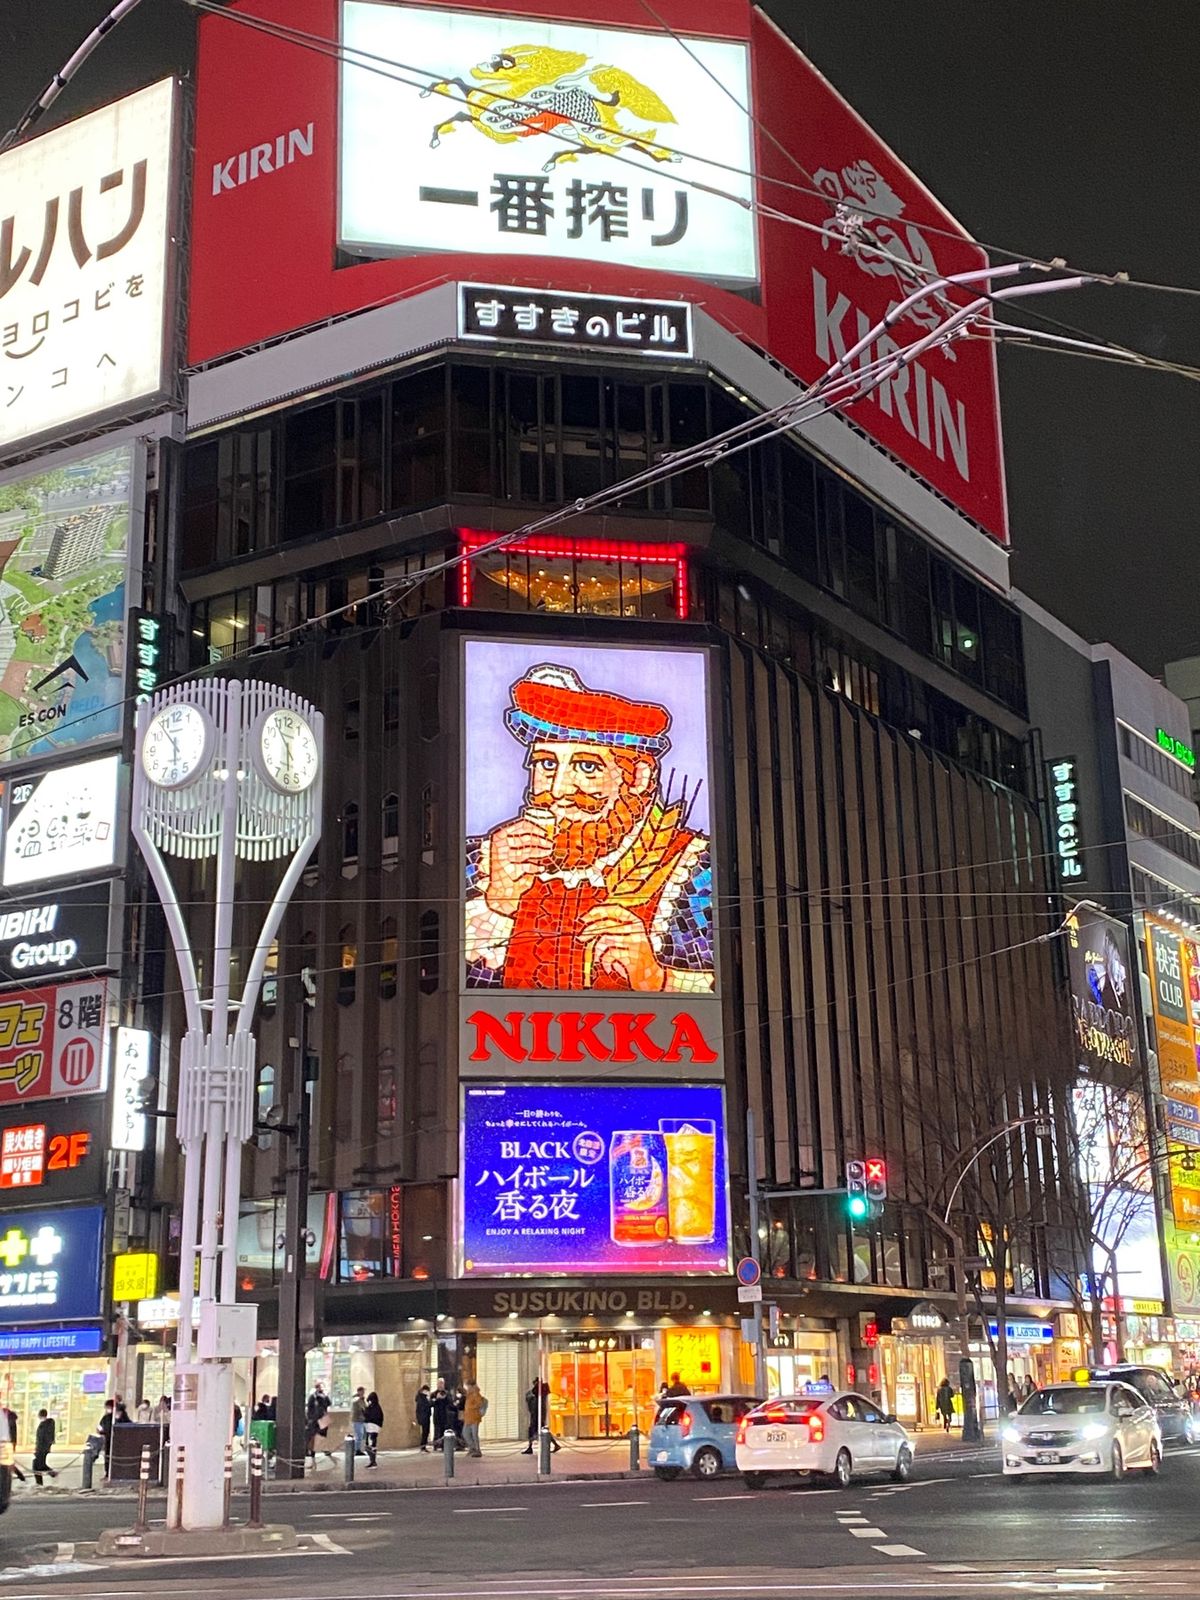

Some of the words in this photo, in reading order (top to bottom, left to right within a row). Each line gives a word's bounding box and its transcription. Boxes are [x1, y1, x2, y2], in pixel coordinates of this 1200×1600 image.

[212, 122, 314, 196] KIRIN
[419, 173, 689, 247] 一番搾り
[474, 300, 677, 343] すすきのビル
[812, 267, 970, 483] KIRIN
[284, 717, 294, 728] 12
[283, 774, 290, 785] 6
[1052, 762, 1082, 877] すすきのビル
[11, 938, 77, 969] Group
[1156, 941, 1180, 980] 快活
[1159, 980, 1183, 1008] CLUB
[58, 995, 102, 1029] 8階
[466, 1011, 718, 1063] NIKKA
[48, 1133, 89, 1170] 2F
[500, 1141, 571, 1159] BLACK
[475, 1164, 595, 1189] ハイボール
[492, 1189, 581, 1221] 香る夜
[486, 1227, 511, 1236] ENJOY
[521, 1227, 559, 1236] RELAXING
[561, 1227, 586, 1235] NIGHT
[493, 1291, 627, 1312] SUSUKINO
[638, 1290, 695, 1311] BLD.
[20, 1336, 41, 1349] HAPPY
[42, 1335, 77, 1348] LIFESTYLE
[1017, 1327, 1041, 1337] LAWSON
